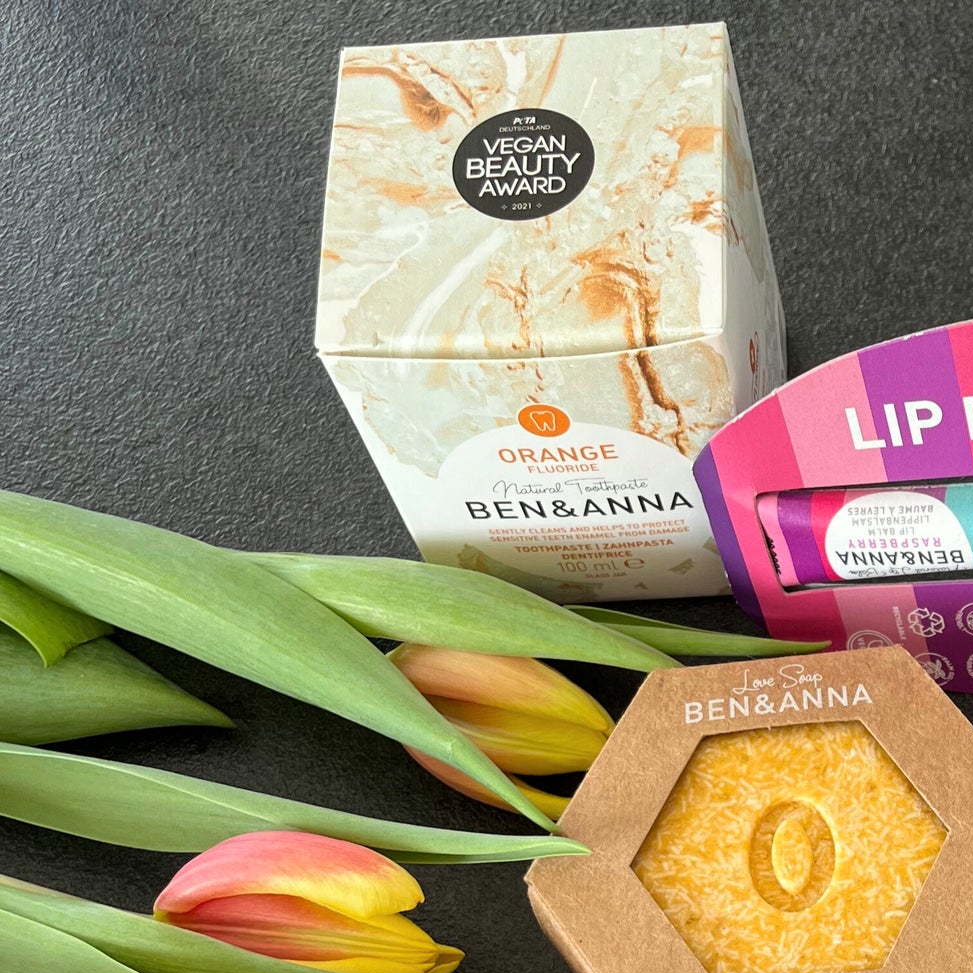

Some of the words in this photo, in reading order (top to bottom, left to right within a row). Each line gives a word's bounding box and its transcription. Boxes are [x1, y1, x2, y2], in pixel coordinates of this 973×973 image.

[499, 124, 551, 133] DEUTSCHLAND
[483, 135, 566, 155] VEGAN
[466, 152, 581, 179] BEAUTY
[478, 176, 566, 197] AWARD
[512, 202, 532, 211] 2021
[845, 400, 943, 450] LIP
[498, 444, 619, 463] ORANGE
[527, 463, 600, 474] FLUORIDE
[492, 480, 563, 498] Natural
[564, 477, 649, 494] Toothpaste
[465, 491, 694, 520] BEN&ANNA
[899, 504, 934, 514] BAUME
[489, 528, 526, 536] GENTLY
[529, 527, 567, 535] CLEANS
[570, 525, 591, 533] AND
[594, 523, 625, 532] HELPS
[627, 522, 640, 530] TO
[641, 519, 686, 529] PROTECT
[851, 515, 930, 527] LIPPENBALSAM
[489, 534, 539, 543] SENSITIVE
[542, 533, 573, 541] TEETH
[575, 531, 617, 540] ENAMEL
[618, 529, 647, 537] FROM
[649, 526, 690, 535] DAMAGE
[868, 527, 896, 536] BALM
[900, 527, 915, 535] LIP
[514, 543, 593, 553] TOOTHPASTE
[603, 538, 675, 550] ZAHNPASTA
[848, 537, 941, 549] RASPBERRY
[561, 550, 633, 560] DENTIFRICE
[835, 550, 965, 566] BEN&ANNA
[557, 561, 587, 573] 100
[593, 559, 619, 571] ml
[892, 606, 907, 640] RECYCLABLE
[732, 669, 775, 695] Love
[779, 664, 823, 690] Soap
[684, 683, 873, 725] BEN&ANNA
[750, 799, 837, 912] O
